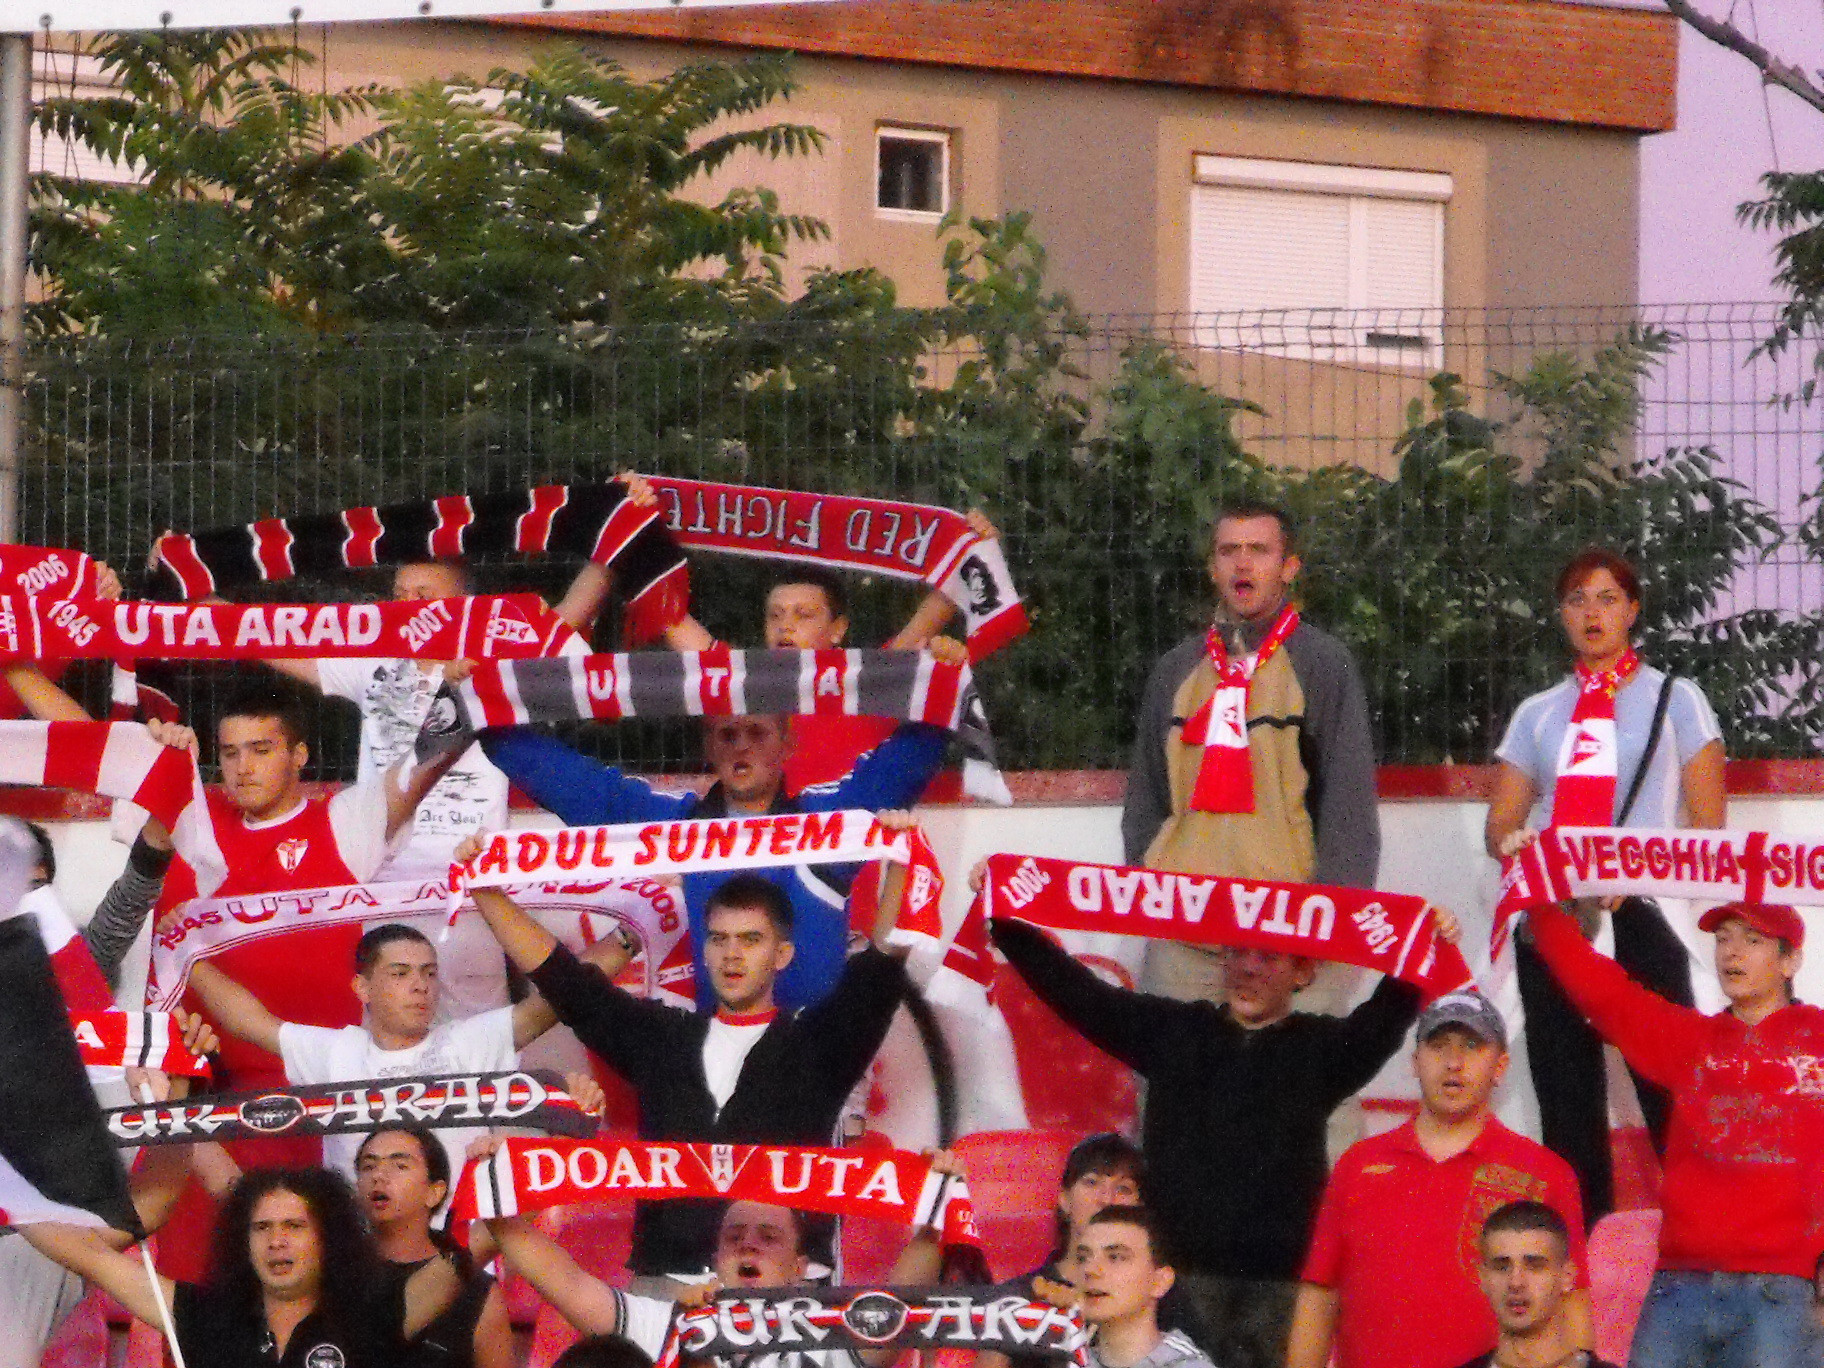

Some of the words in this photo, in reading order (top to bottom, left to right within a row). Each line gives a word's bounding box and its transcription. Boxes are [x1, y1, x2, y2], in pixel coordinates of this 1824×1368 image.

[865, 508, 942, 568] RED
[46, 600, 101, 648] 1945
[113, 604, 221, 648] UTA
[234, 605, 382, 648] ARAD
[398, 599, 453, 653] 2007
[634, 812, 845, 866] SUNTEM
[999, 857, 1052, 909] 2007
[1067, 865, 1218, 924] ARAD
[1230, 883, 1336, 942] UTA
[1351, 901, 1398, 956] 1945
[108, 1104, 224, 1140] UR
[319, 1073, 549, 1127] ARAD
[523, 1147, 687, 1192] DOAR
[766, 1150, 905, 1206] UTA
[925, 1297, 1091, 1350] ARA
